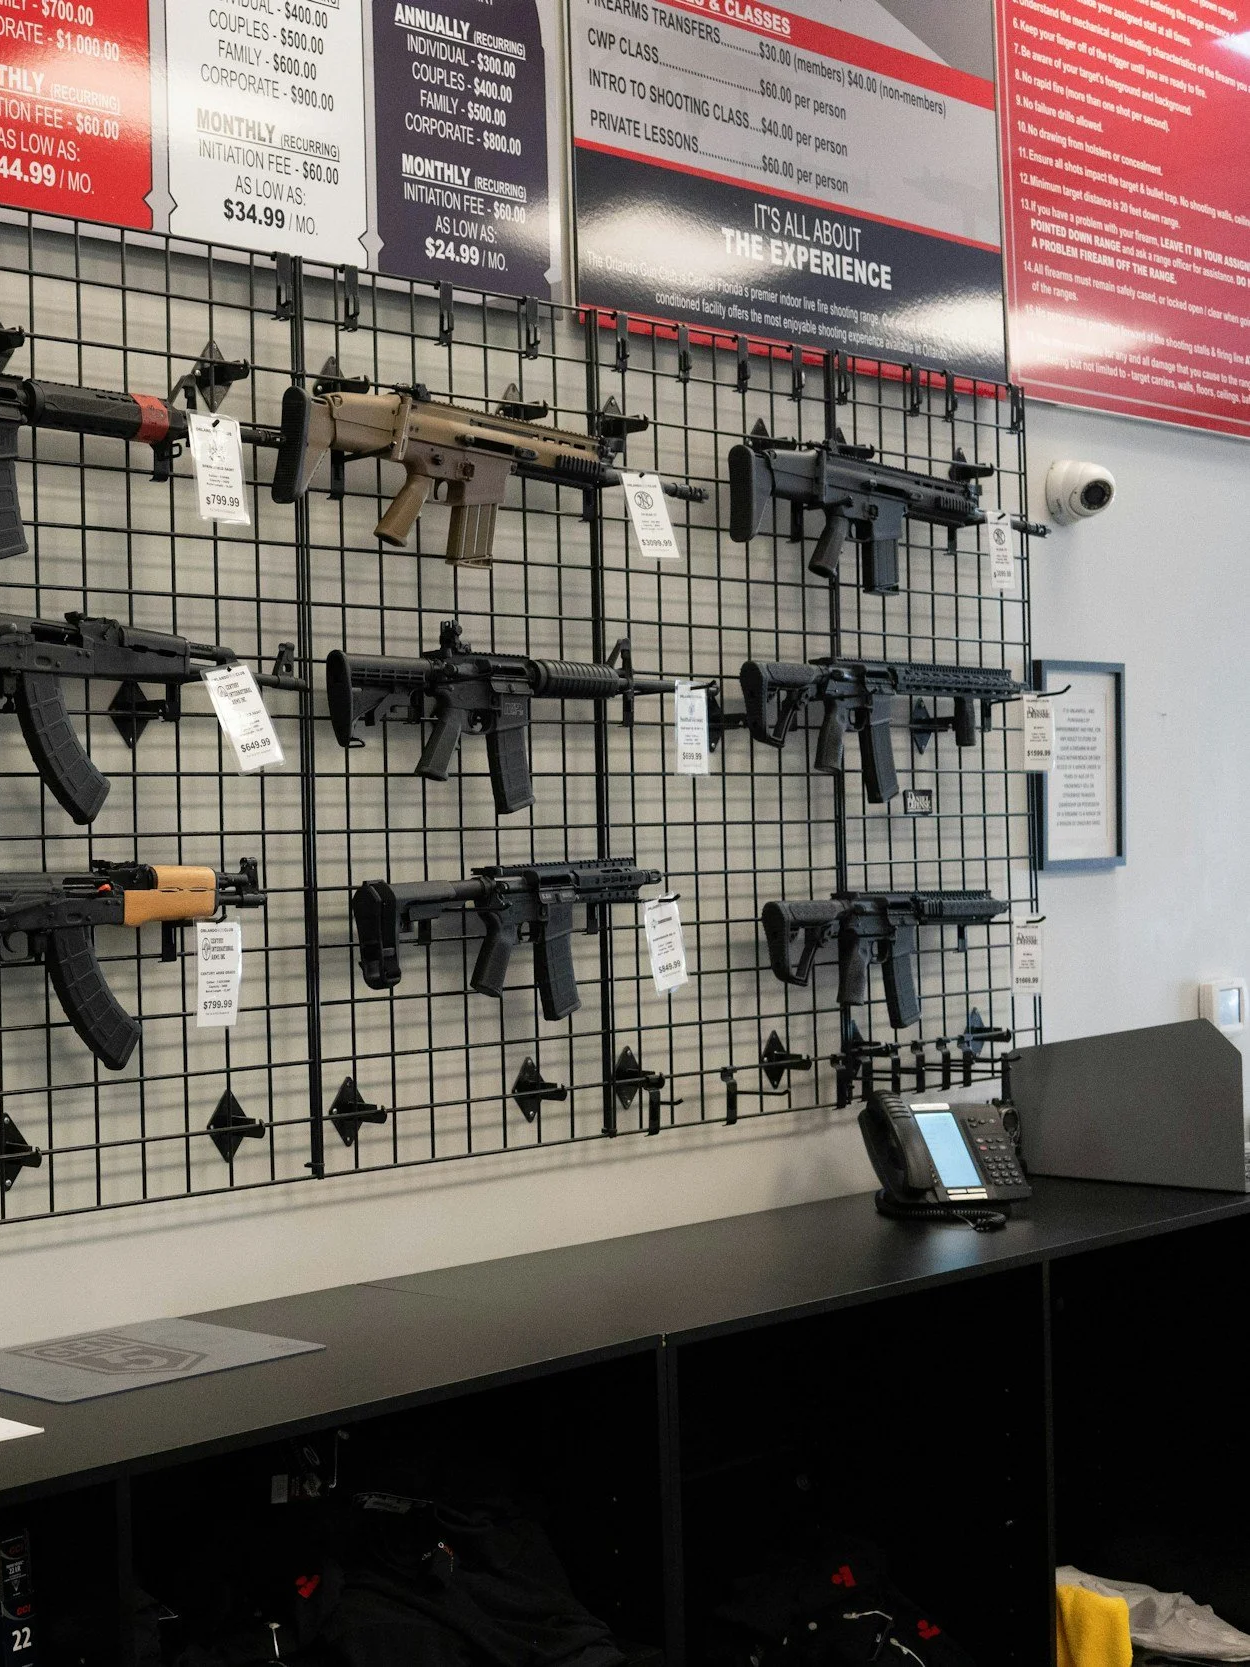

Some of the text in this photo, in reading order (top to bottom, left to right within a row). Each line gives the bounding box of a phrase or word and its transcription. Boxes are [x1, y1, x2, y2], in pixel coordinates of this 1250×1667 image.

[41, 0, 94, 27] $700.00
[209, 9, 324, 55] COUPLES $500.00
[284, 1, 328, 29] $400.00
[394, 3, 526, 58] ANNUALLY (RECURRING)
[725, 0, 791, 35] CLASSES
[218, 39, 317, 80] FAMILY $600.00
[407, 33, 516, 79] INDIVIDUAL $300.00
[587, 27, 616, 50] CWP
[794, 94, 810, 110] per
[813, 98, 846, 120] person
[50, 83, 121, 113] (RECURRING)
[201, 63, 334, 112] CORPORATE $900.00
[412, 61, 512, 104] COUPLES $400.00
[793, 56, 846, 88] (members)
[848, 71, 877, 94] $40.00
[879, 80, 947, 120] (non-members)
[1033, 77, 1052, 91] rapid
[1052, 81, 1064, 95] fire
[35, 104, 63, 129] FEE
[76, 112, 120, 140] $60.00
[420, 89, 507, 127] FAMILY $500.00
[589, 68, 627, 95] INTRO
[630, 79, 646, 100] TO
[650, 86, 710, 118] SHOOTING
[796, 130, 812, 147] per
[814, 135, 848, 157] person
[1034, 100, 1057, 117] failure
[1058, 109, 1075, 123] drills
[1076, 115, 1103, 133] allowed.
[20, 131, 55, 156] LOW
[57, 140, 81, 162] AS:
[197, 108, 340, 159] MONTHLY (RECURRING)
[405, 112, 522, 157] CORPORATE $800.00
[590, 109, 641, 138] PRIVATE
[796, 167, 812, 184] per
[815, 172, 849, 194] person
[199, 139, 339, 185] INITIATION FEE $60.00
[402, 153, 527, 200] MONTHLY (RECURRING)
[67, 172, 95, 195] MO.
[235, 175, 306, 206] AS LOW AS:
[223, 198, 318, 236] $34.99 MO.
[404, 182, 526, 224] INITIATION FEE $60.00
[435, 215, 498, 245] AS LOW AS:
[754, 202, 862, 252] IT'S ALL ABOUT
[1031, 218, 1121, 253] POINTED DOWN RANGE
[425, 236, 509, 272] $24.99 MO.
[721, 227, 763, 261] THE
[770, 238, 892, 291] EXPERIENCE
[1031, 236, 1177, 284] A PROBLEM FIREARM OFF THE RANGE.
[1160, 237, 1223, 264] LEAVE IT IN YOUR
[655, 292, 700, 311] conditioned
[702, 299, 726, 320] facility
[727, 304, 749, 321] offers
[750, 308, 762, 322] the
[764, 313, 782, 327] most
[783, 318, 817, 334] enjoyable
[818, 322, 847, 343] shooting
[206, 494, 240, 507] $799.99
[240, 737, 271, 753] $649.99
[203, 1000, 233, 1010] $799.99
[16, 1603, 31, 1616] CCI
[12, 1627, 32, 1652] 22
